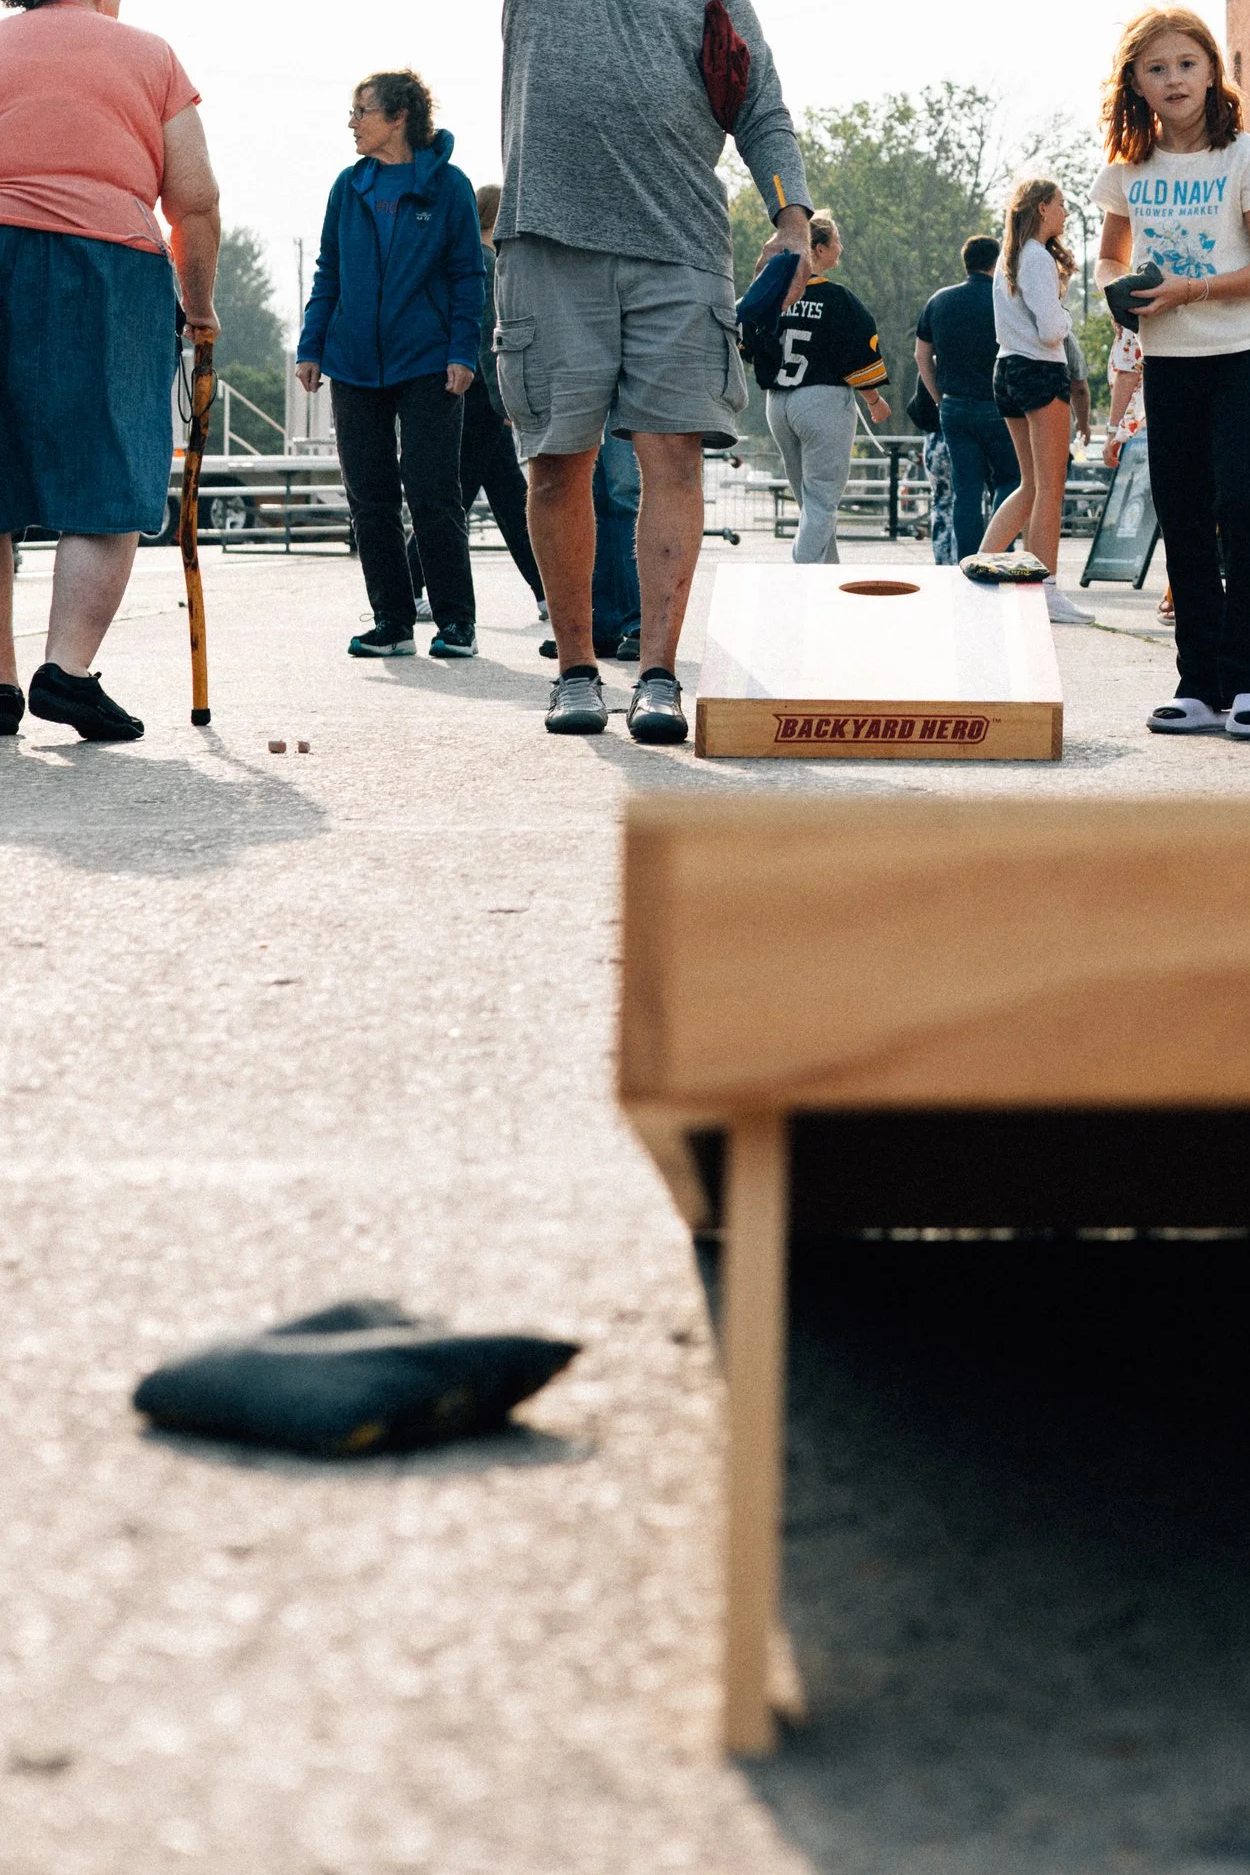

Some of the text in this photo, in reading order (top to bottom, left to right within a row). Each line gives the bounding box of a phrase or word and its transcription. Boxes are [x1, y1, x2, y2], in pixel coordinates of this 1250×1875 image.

[1129, 175, 1228, 206] OLD NAVY
[1134, 205, 1219, 218] FLOWER MARKET
[777, 328, 812, 387] 5
[781, 718, 917, 740] BACKYARD
[919, 719, 986, 741] HERO
